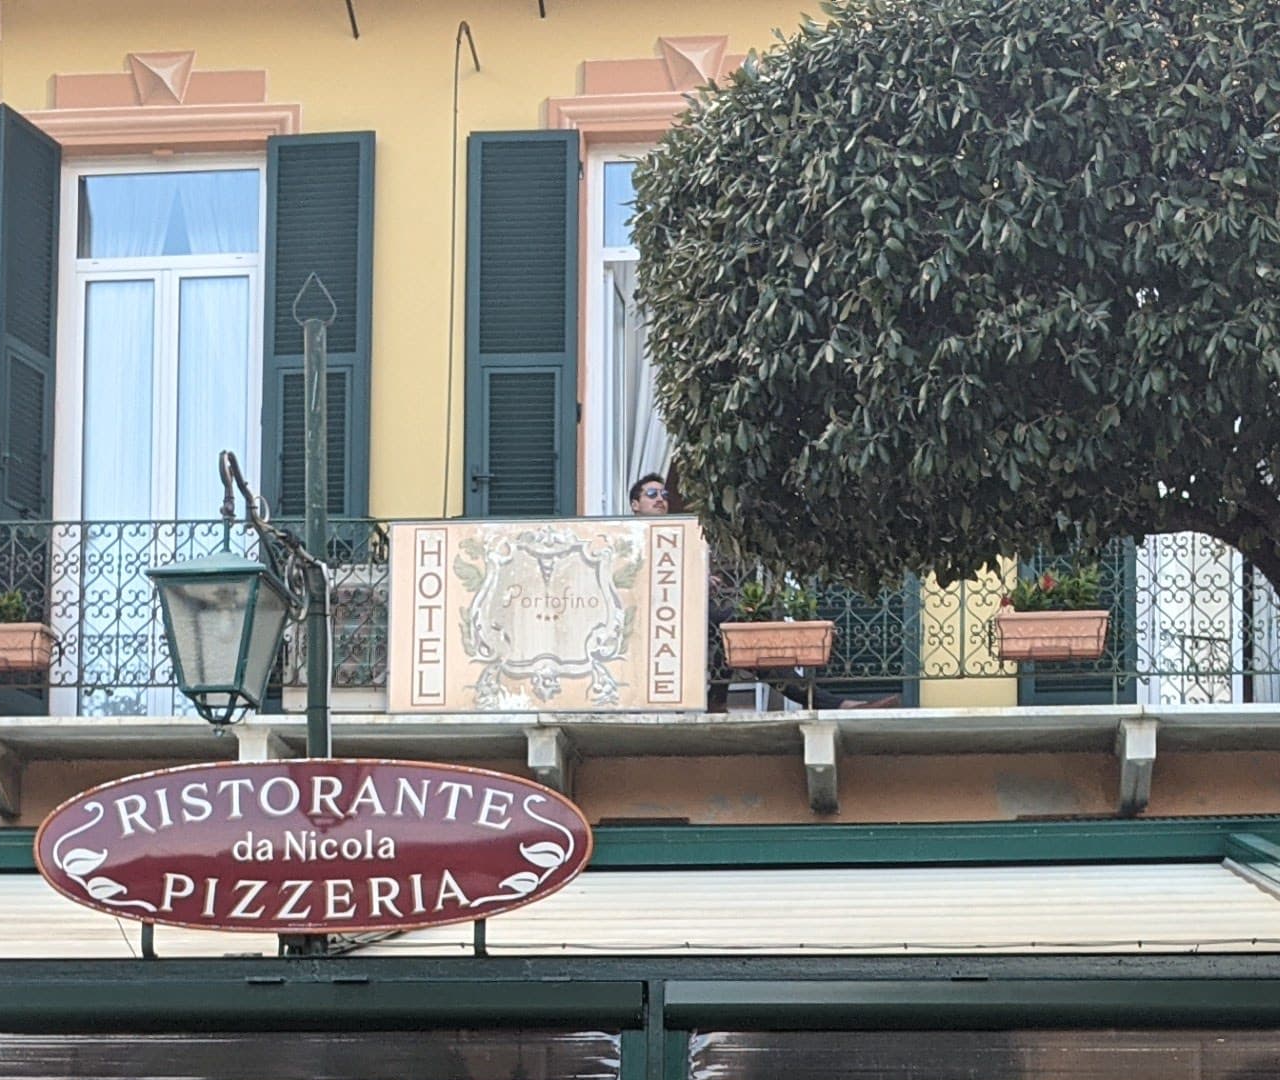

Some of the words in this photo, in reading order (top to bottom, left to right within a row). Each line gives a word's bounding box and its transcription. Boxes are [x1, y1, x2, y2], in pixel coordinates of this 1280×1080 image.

[418, 540, 442, 698] HOTEL
[502, 584, 599, 614] Portofino
[654, 533, 678, 695] NAZIONALE
[114, 776, 516, 837] RISTORANTE
[233, 830, 274, 862] da
[284, 829, 396, 862] Nicola
[160, 869, 472, 920] PIZZERIA
